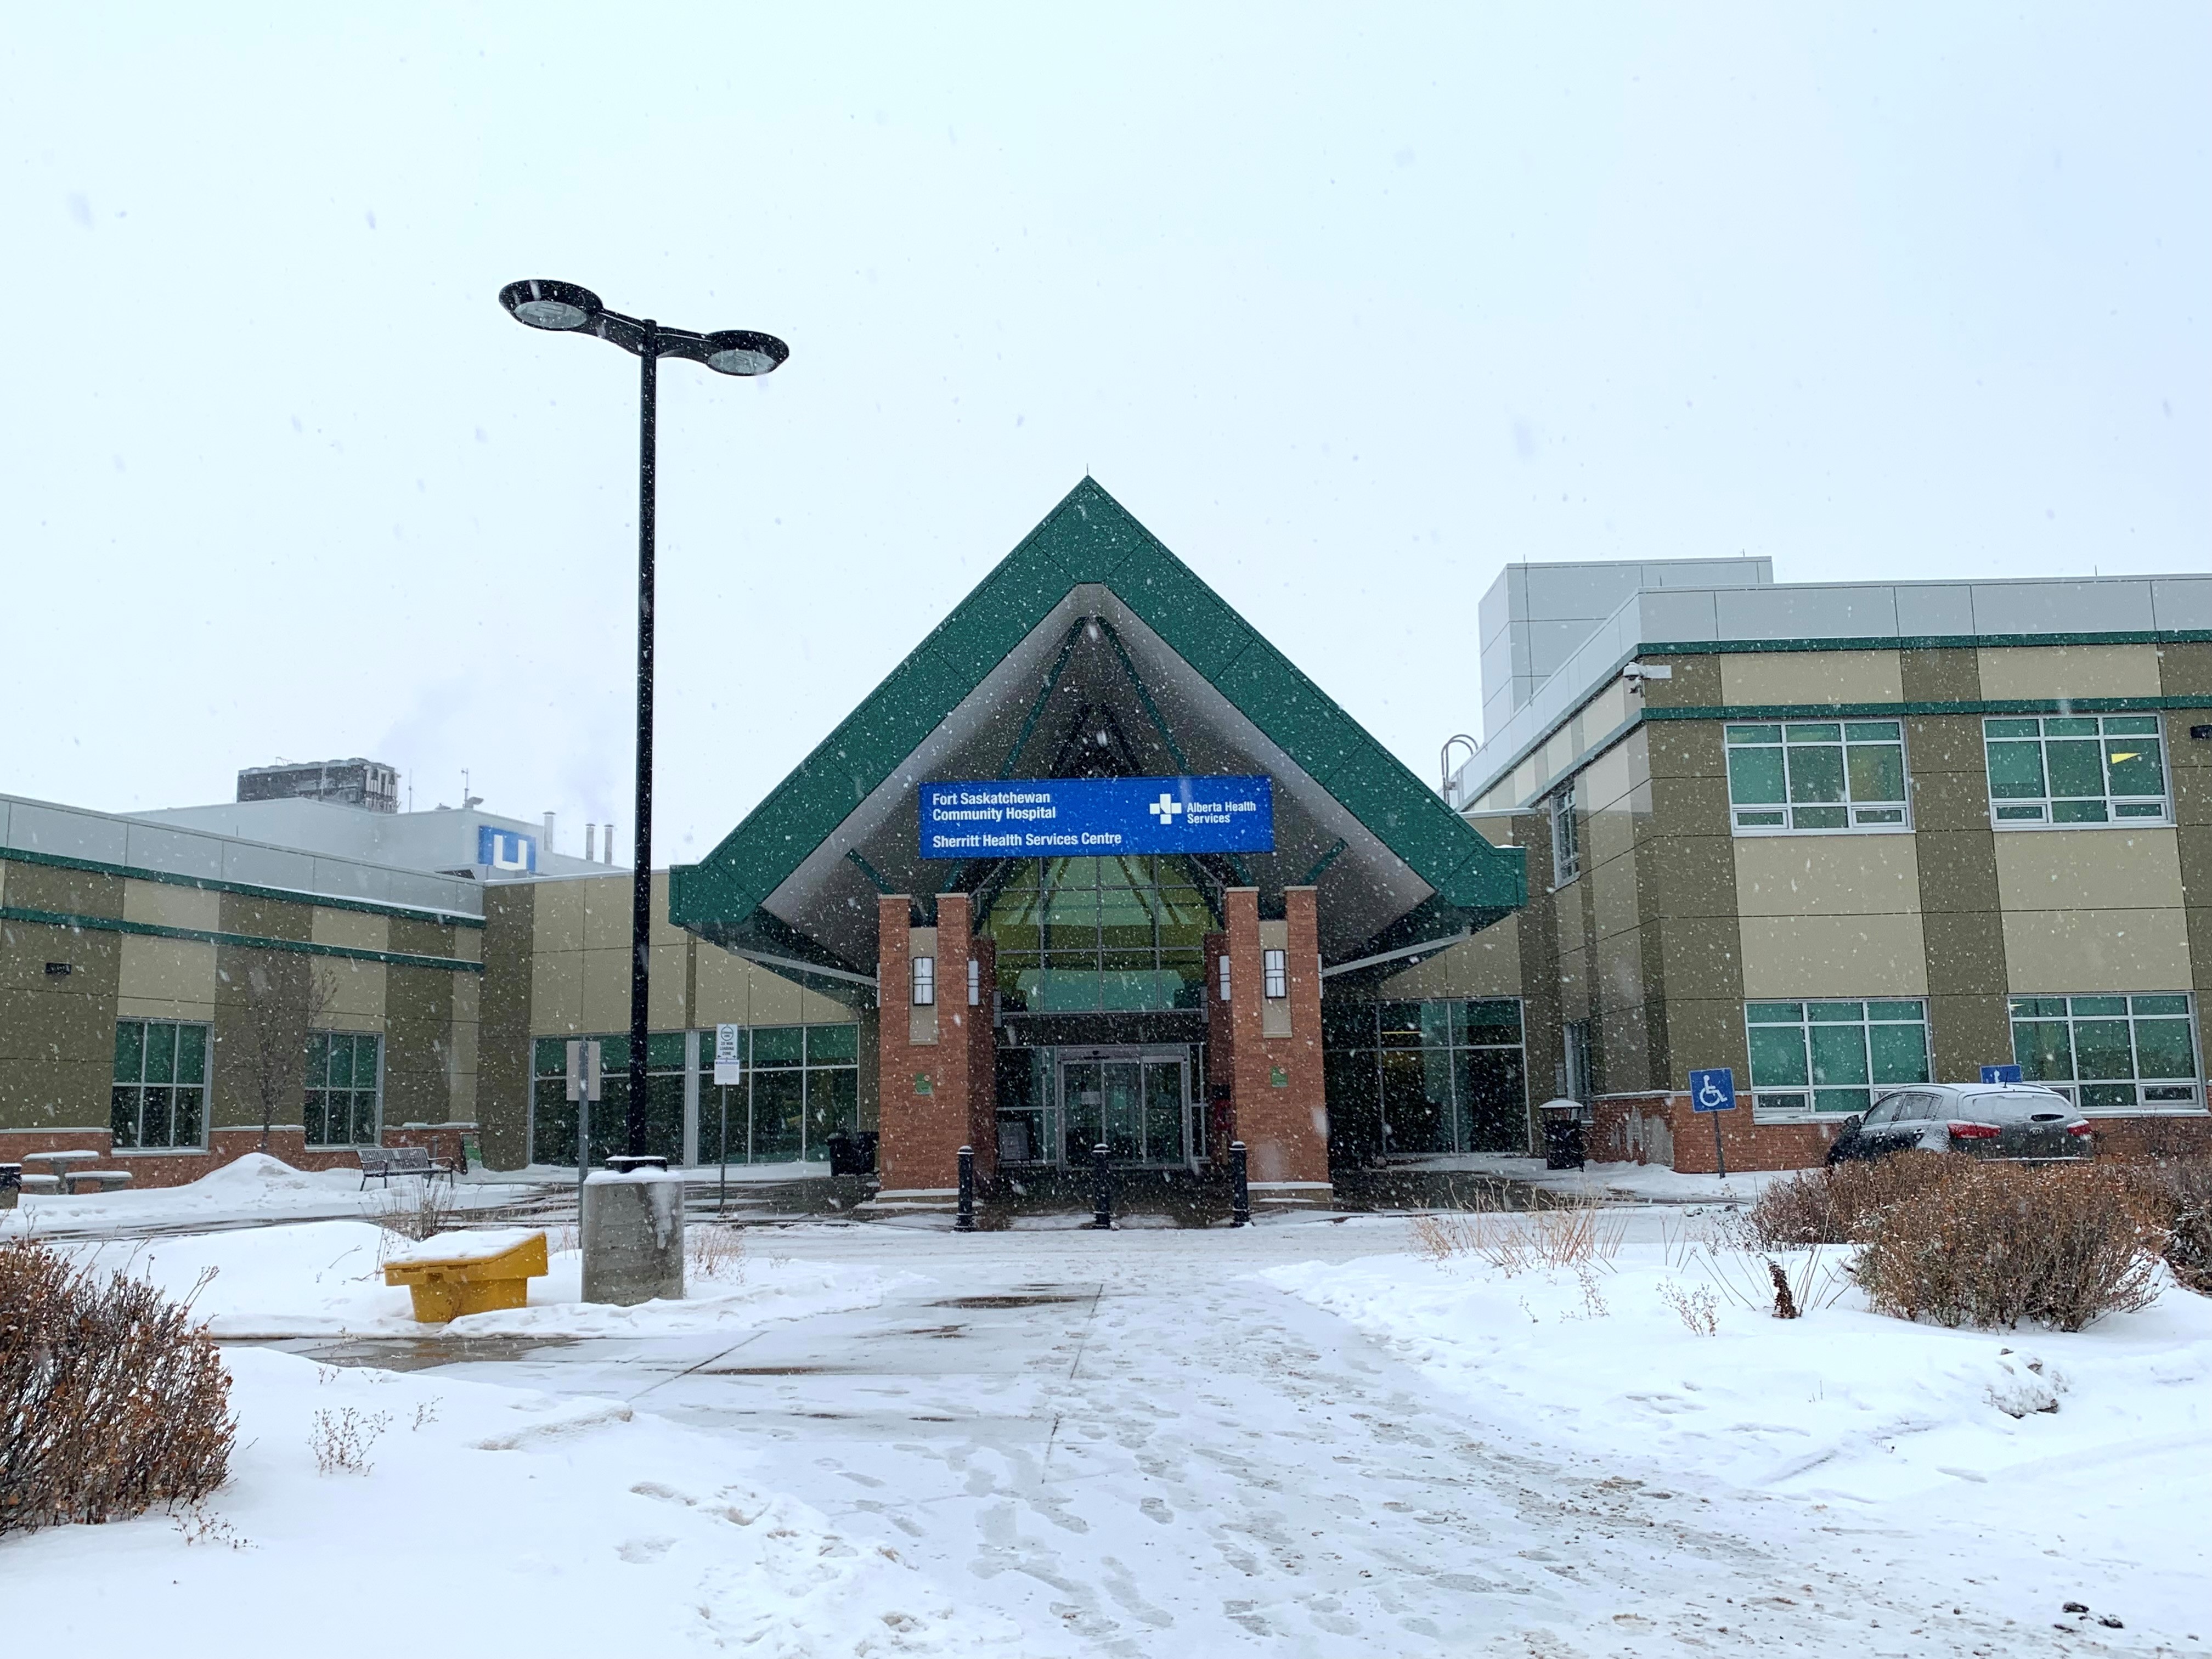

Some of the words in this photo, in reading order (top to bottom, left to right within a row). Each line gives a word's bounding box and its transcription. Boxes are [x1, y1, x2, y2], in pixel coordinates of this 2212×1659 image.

[932, 793, 957, 805] Fort
[960, 792, 1051, 805] Saskatchewan
[1187, 802, 1222, 812] Alberta
[1224, 801, 1256, 812] Health
[933, 807, 1002, 822] Community
[1006, 806, 1056, 821] Hospital
[1187, 813, 1231, 824] Services
[933, 834, 981, 848] Sherritt
[983, 834, 1022, 847] Health
[1025, 833, 1078, 846] Services
[1081, 832, 1122, 844] Centre
